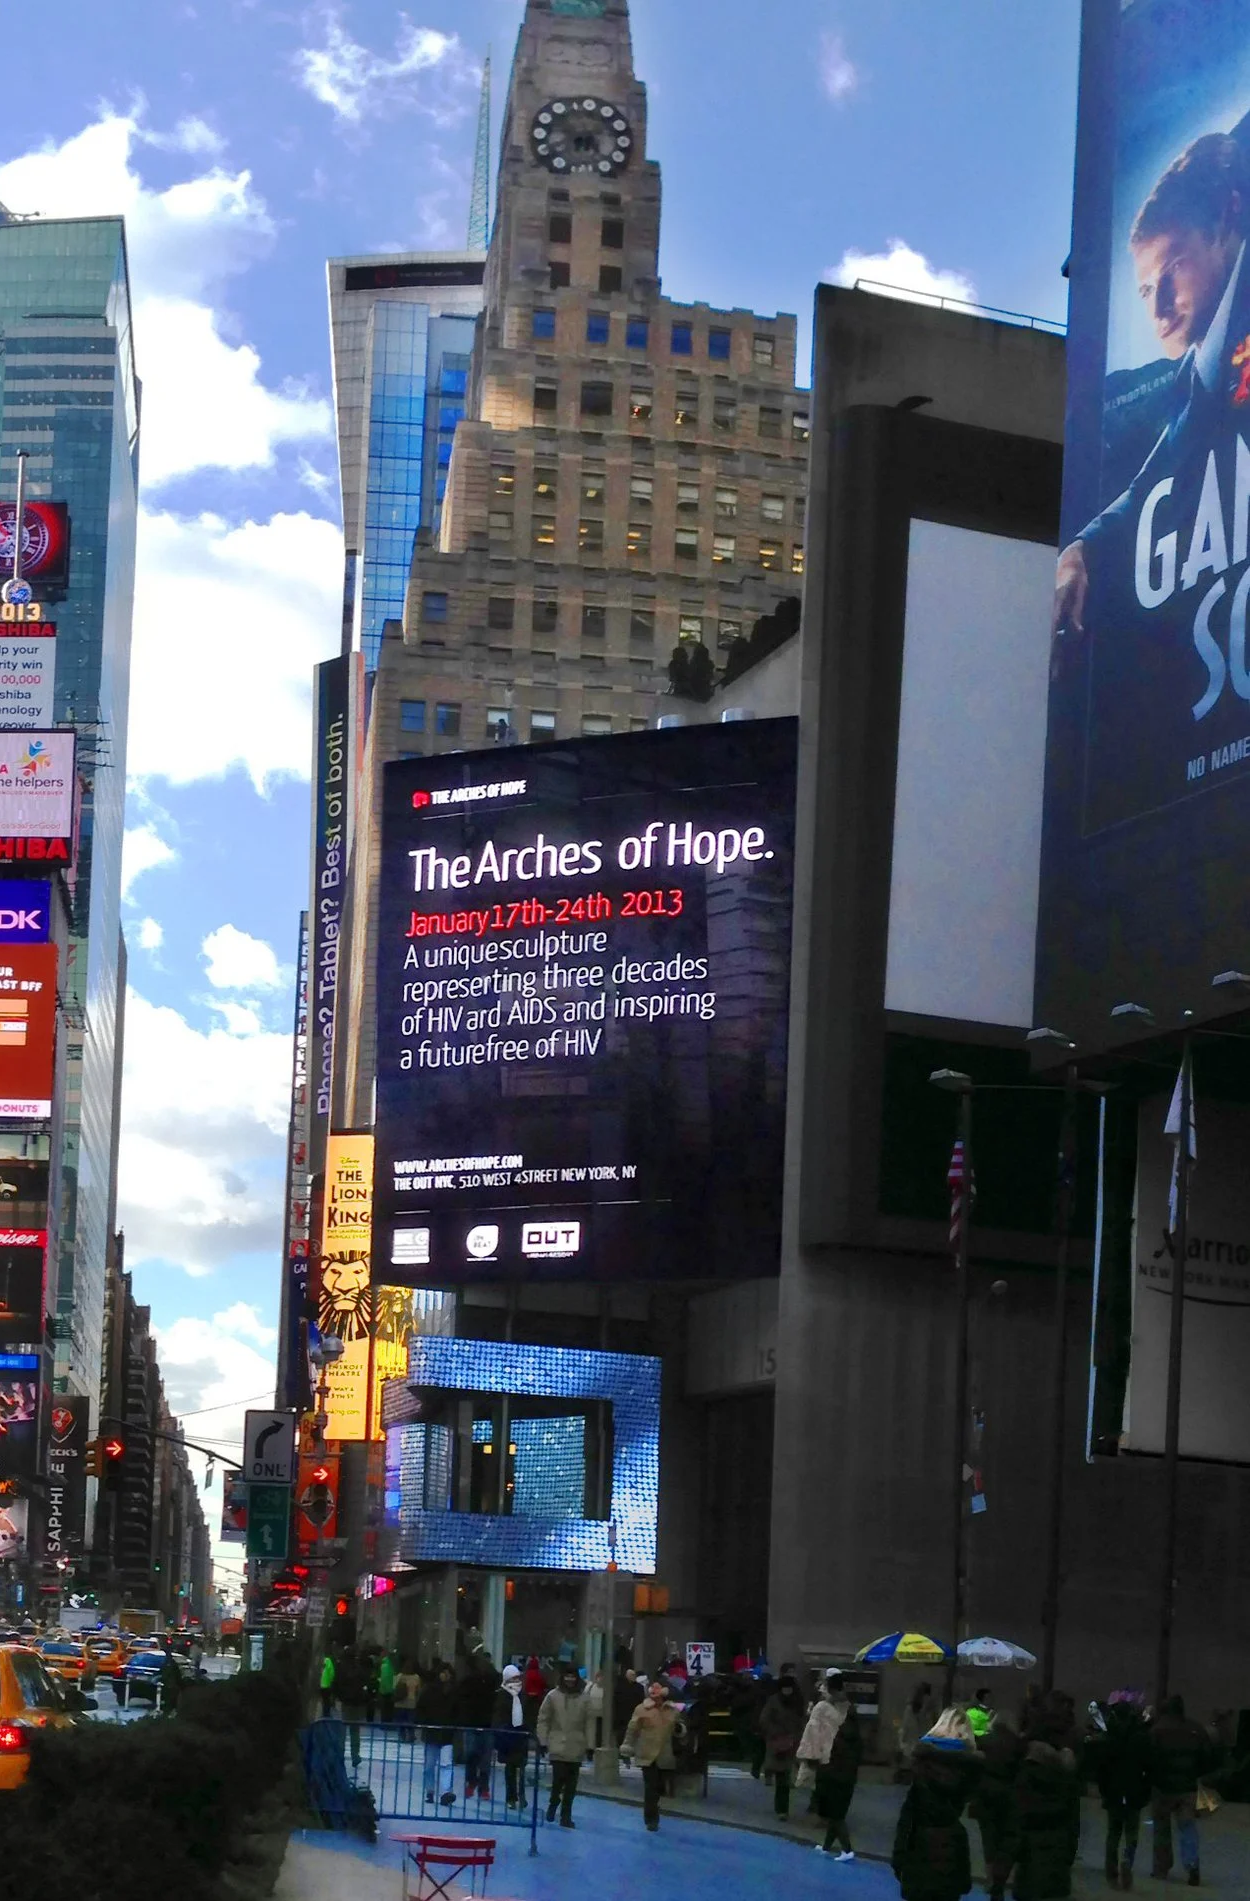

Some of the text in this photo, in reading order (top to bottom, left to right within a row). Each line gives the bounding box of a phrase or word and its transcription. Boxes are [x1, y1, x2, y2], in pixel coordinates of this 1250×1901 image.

[12, 647, 40, 656] your
[22, 660, 43, 669] win
[325, 712, 344, 789] both.
[1187, 755, 1206, 781] NO
[15, 777, 63, 789] helpers
[431, 780, 527, 804] THE ARCHES OF HOPE
[326, 794, 343, 818] of
[321, 826, 342, 888] Best
[617, 822, 664, 870] of
[667, 822, 774, 874] Hope.
[621, 889, 683, 917] 2013
[319, 898, 340, 999] Tablet?
[403, 944, 419, 969] A
[543, 963, 604, 990] three
[612, 952, 708, 983] decades
[20, 980, 43, 992] BFF
[401, 1007, 426, 1035] of
[428, 1006, 464, 1032] HIV
[507, 997, 557, 1025] AIDS
[563, 992, 606, 1022] and
[614, 987, 716, 1023] inspiring
[400, 1027, 602, 1070] a of HIV
[336, 1170, 362, 1181] THE
[394, 1155, 523, 1174] WWW.ARCHESOFHOPE.COM
[393, 1177, 412, 1191] THE
[412, 1176, 433, 1190] OUT
[458, 1175, 480, 1189] 510
[482, 1173, 511, 1187] WEST
[561, 1167, 587, 1181] NEW
[587, 1166, 620, 1182] YORK,
[622, 1165, 638, 1179] NY
[527, 1230, 575, 1245] OUT
[1138, 1264, 1170, 1279] NEW
[1184, 1271, 1214, 1286] ORK
[252, 1462, 286, 1477] ONL
[47, 1463, 65, 1552] SAPPHIE
